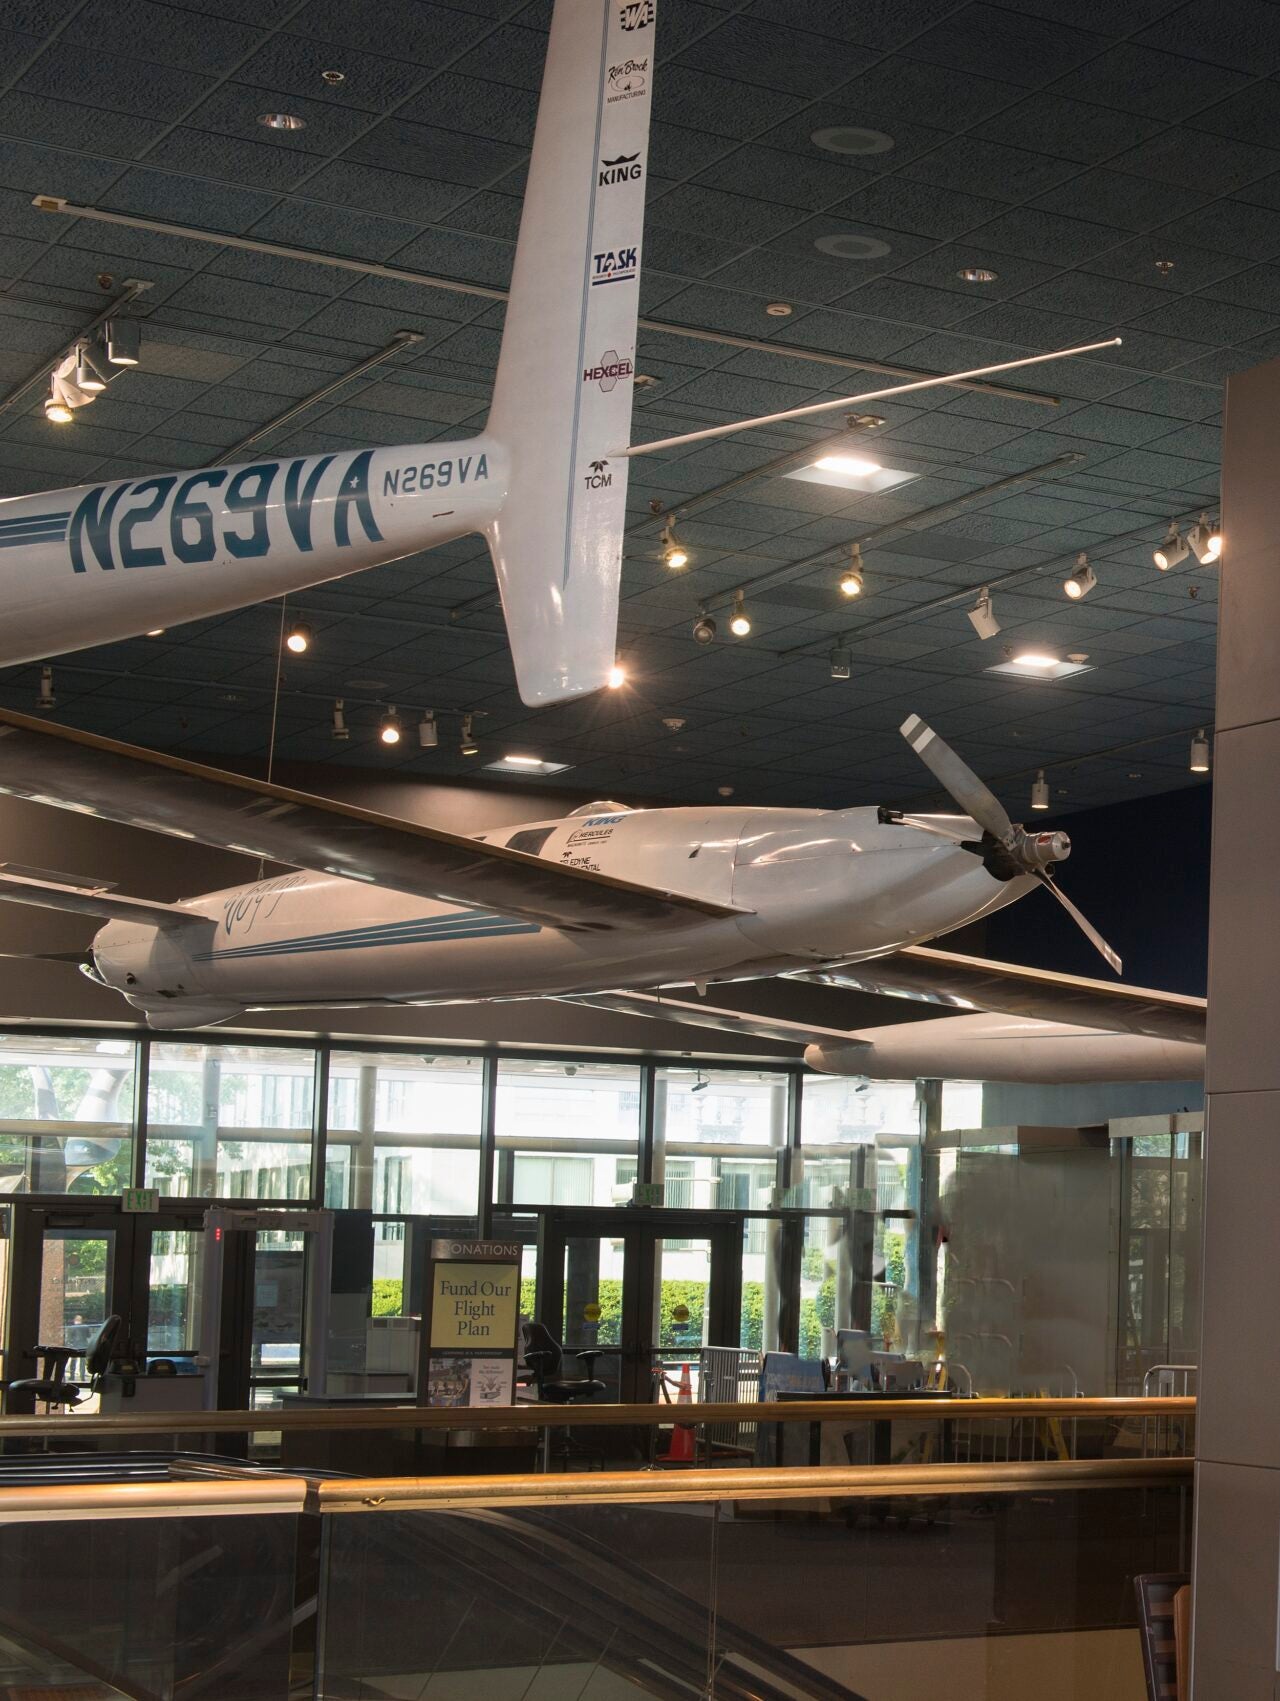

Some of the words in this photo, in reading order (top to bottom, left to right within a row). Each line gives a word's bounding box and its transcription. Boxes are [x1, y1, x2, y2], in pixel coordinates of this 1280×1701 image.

[624, 58, 648, 75] Brock
[607, 90, 646, 104] MANUFACTURING
[599, 164, 642, 187] KING
[594, 247, 637, 274] TASK
[583, 362, 633, 381] HEXCEL
[383, 454, 489, 497] N269VA
[584, 474, 612, 490] TCM
[68, 450, 385, 574] N269VA
[127, 1190, 154, 1210] EXIT
[441, 1280, 477, 1296] Fund
[481, 1281, 511, 1297] Our
[454, 1301, 495, 1320] Flight
[458, 1320, 490, 1336] Plan
